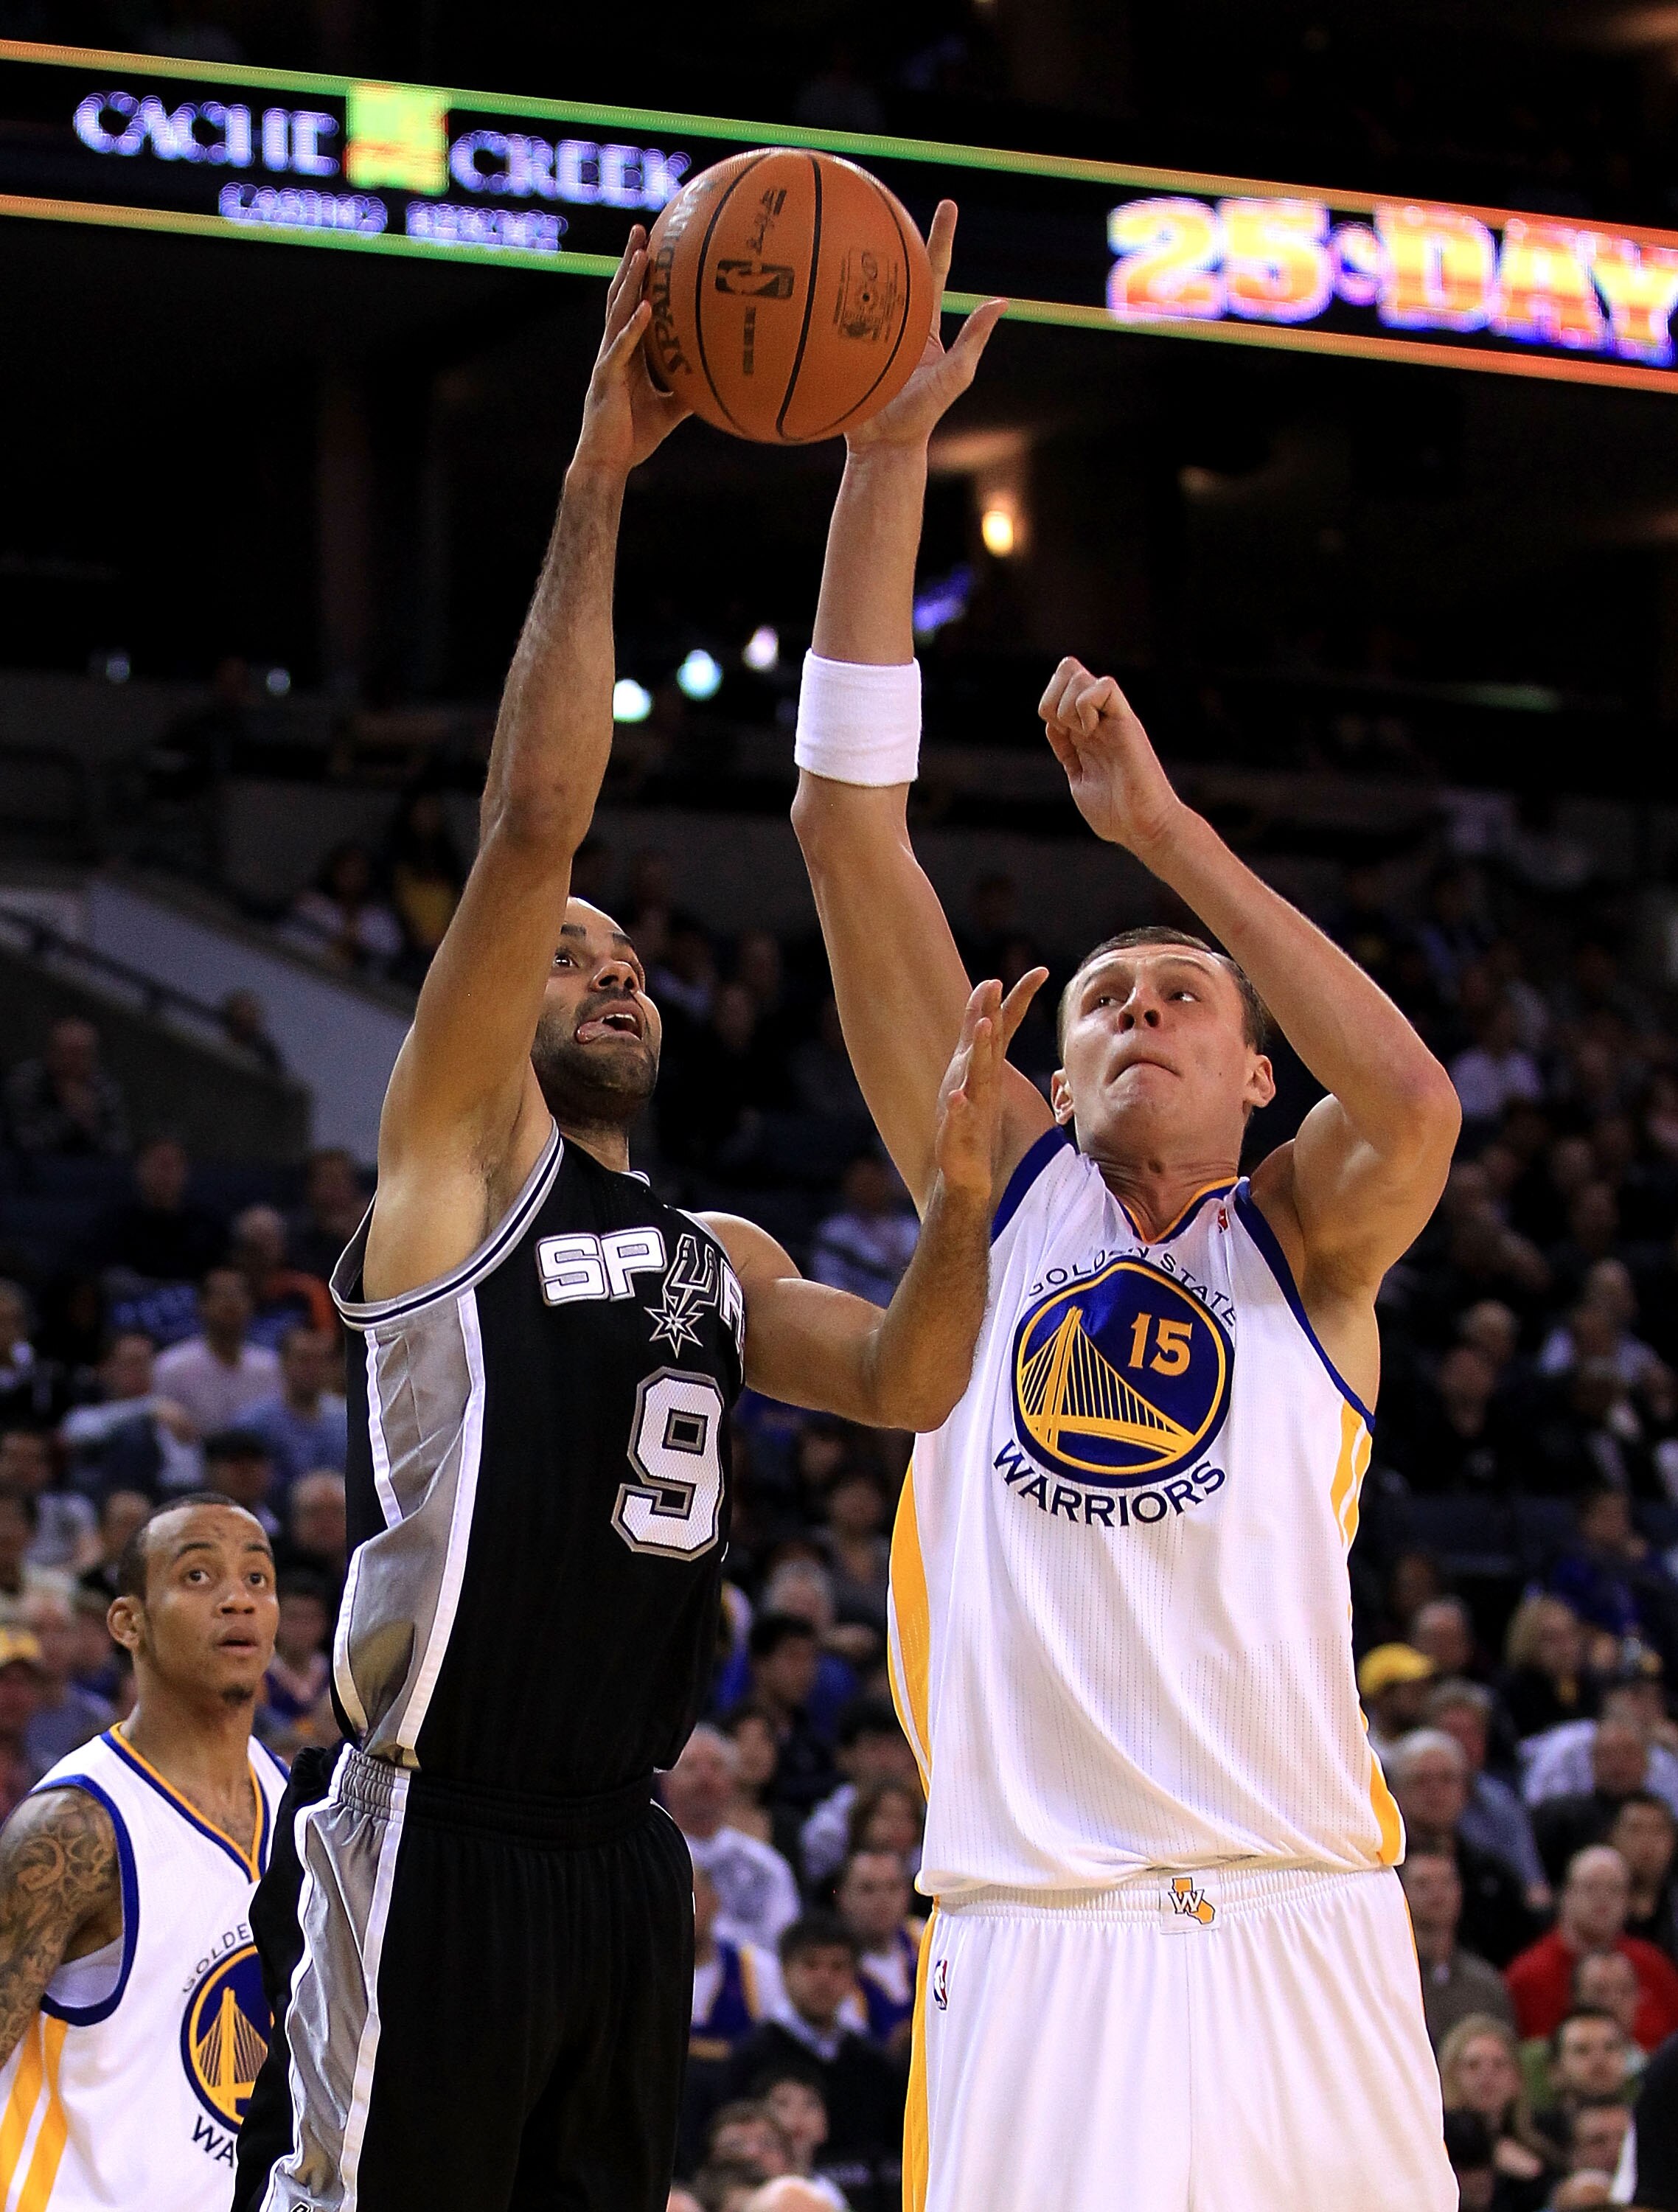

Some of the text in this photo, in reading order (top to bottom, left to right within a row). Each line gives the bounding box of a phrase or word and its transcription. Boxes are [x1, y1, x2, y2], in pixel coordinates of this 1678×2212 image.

[1160, 1253, 1236, 1327] STATE
[1127, 1312, 1193, 1377] 15
[610, 1366, 724, 1562] 9
[993, 1439, 1226, 1527] WARRIORS
